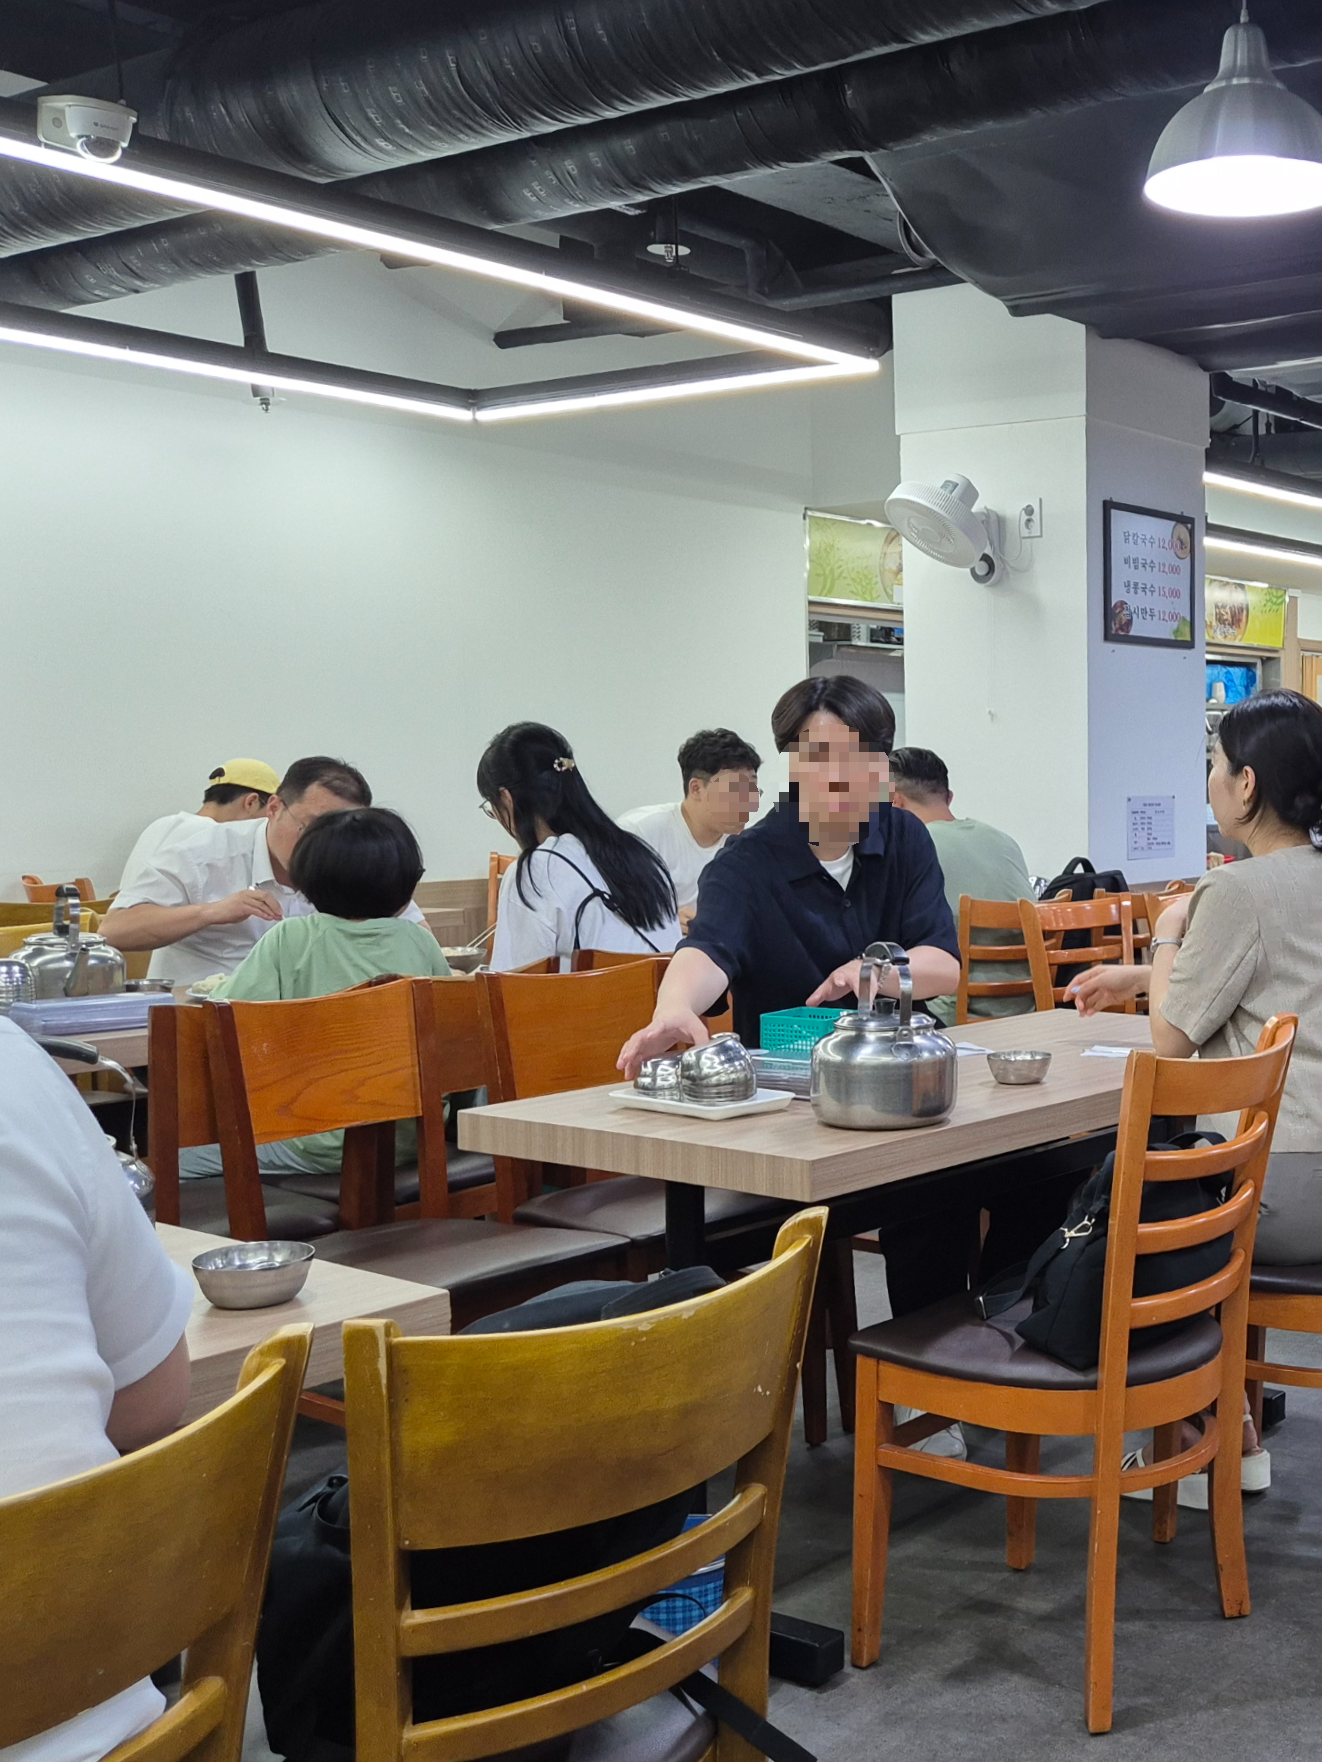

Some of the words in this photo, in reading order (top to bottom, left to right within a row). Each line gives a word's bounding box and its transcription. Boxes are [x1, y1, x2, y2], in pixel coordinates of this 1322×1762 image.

[1123, 530, 1156, 548] 닭칼국수
[1158, 537, 1182, 551] 12,000
[1123, 555, 1156, 573] 비빔국수
[1158, 562, 1181, 575] 12,000
[1123, 580, 1156, 597] 냉콩국수
[1158, 586, 1181, 600] 15,000
[1158, 610, 1181, 623] 12,000
